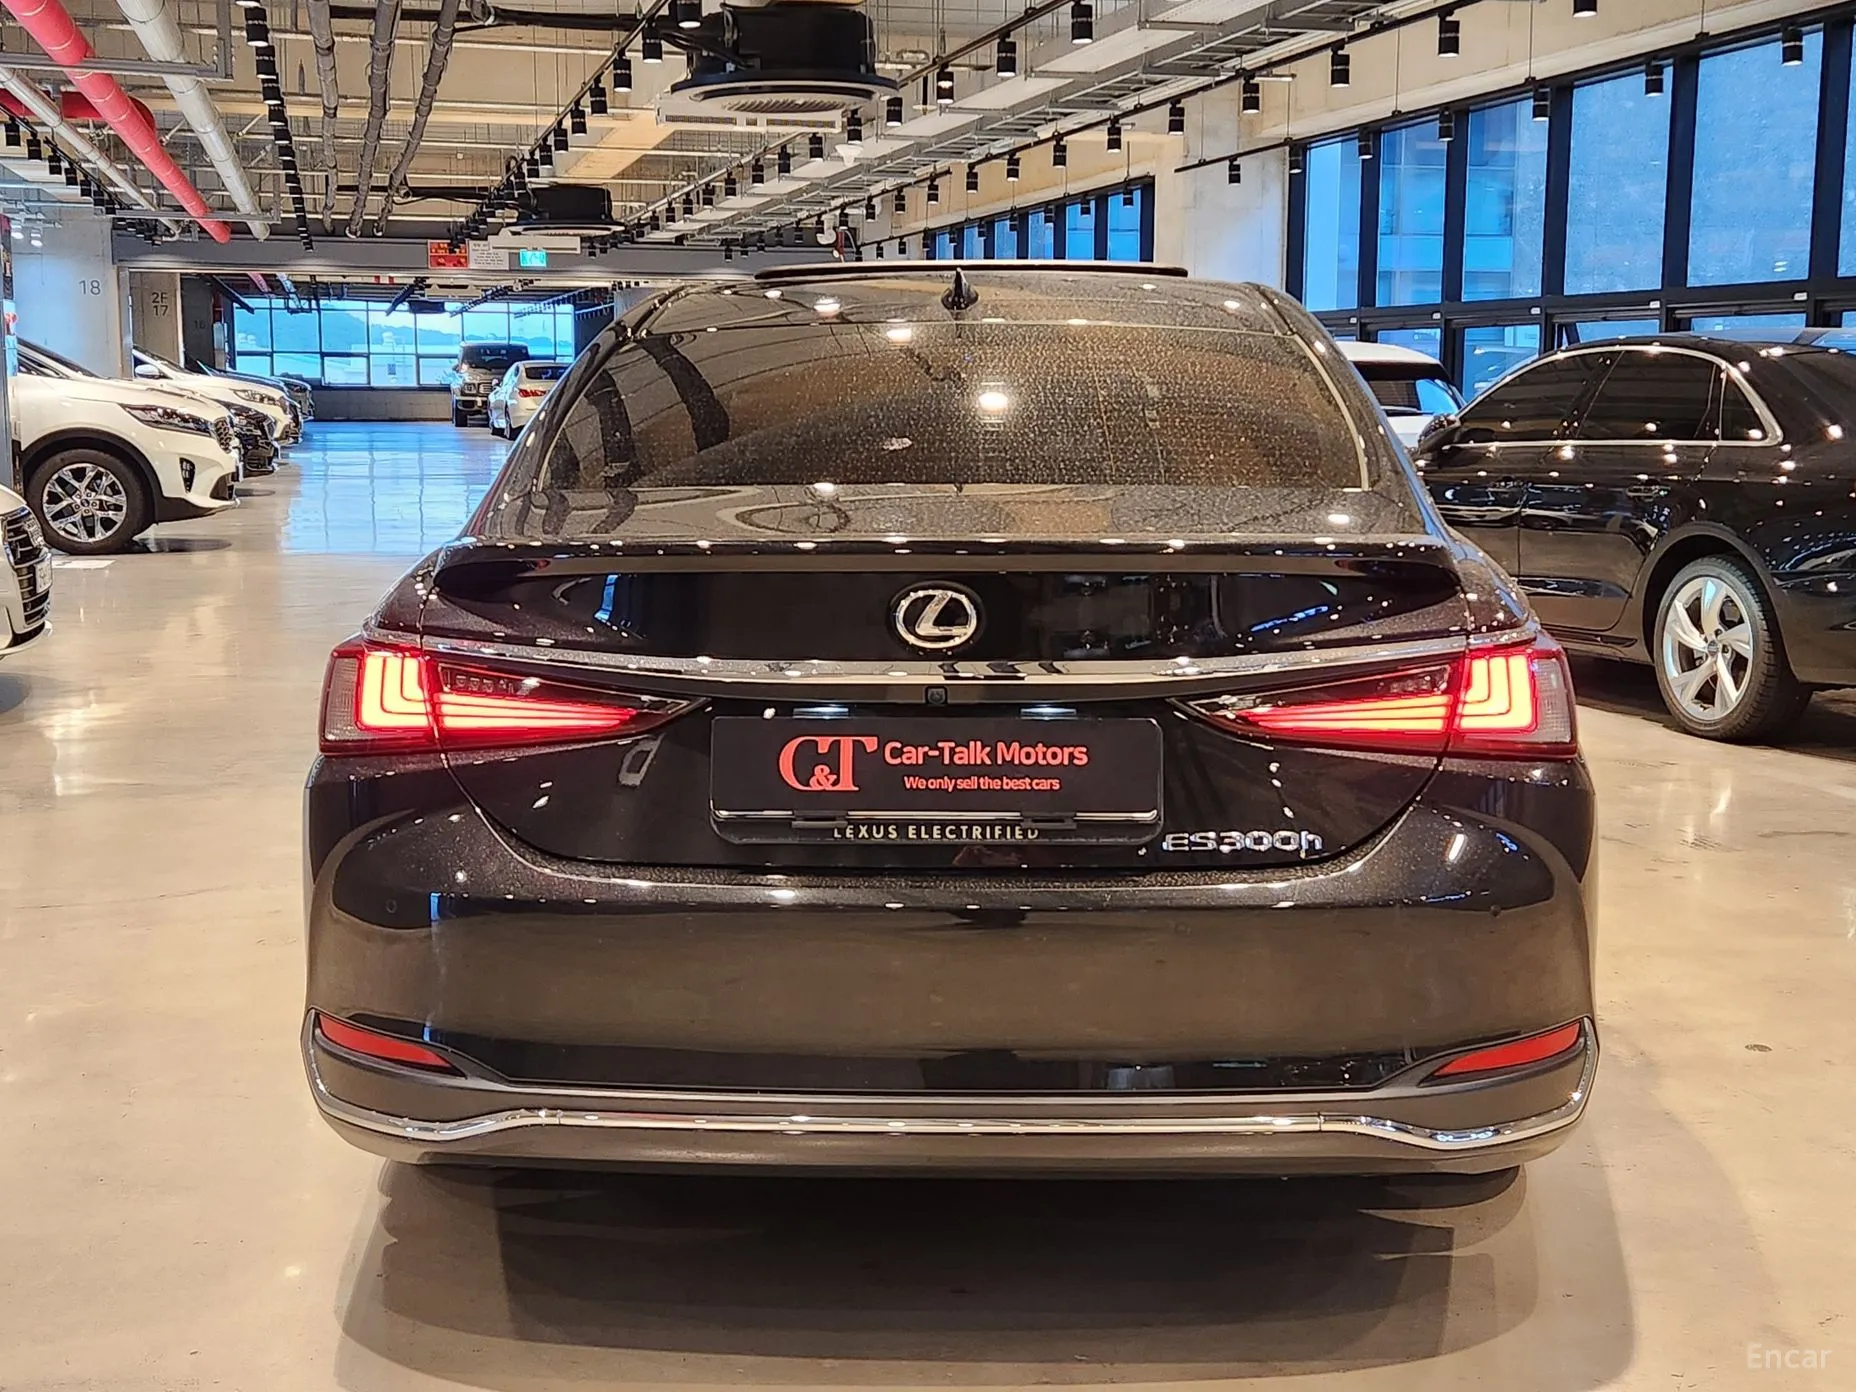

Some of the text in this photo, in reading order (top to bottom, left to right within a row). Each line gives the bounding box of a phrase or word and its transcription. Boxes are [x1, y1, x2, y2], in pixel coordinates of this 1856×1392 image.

[78, 280, 101, 296] 18
[151, 292, 168, 304] 2F
[153, 305, 168, 317] 17
[884, 741, 1089, 766] Car-Talk Motors
[904, 775, 1060, 793] We only sell the best cars
[833, 824, 1039, 839] LEXUS ELECTRIFIED
[1162, 830, 1323, 853] ES300h
